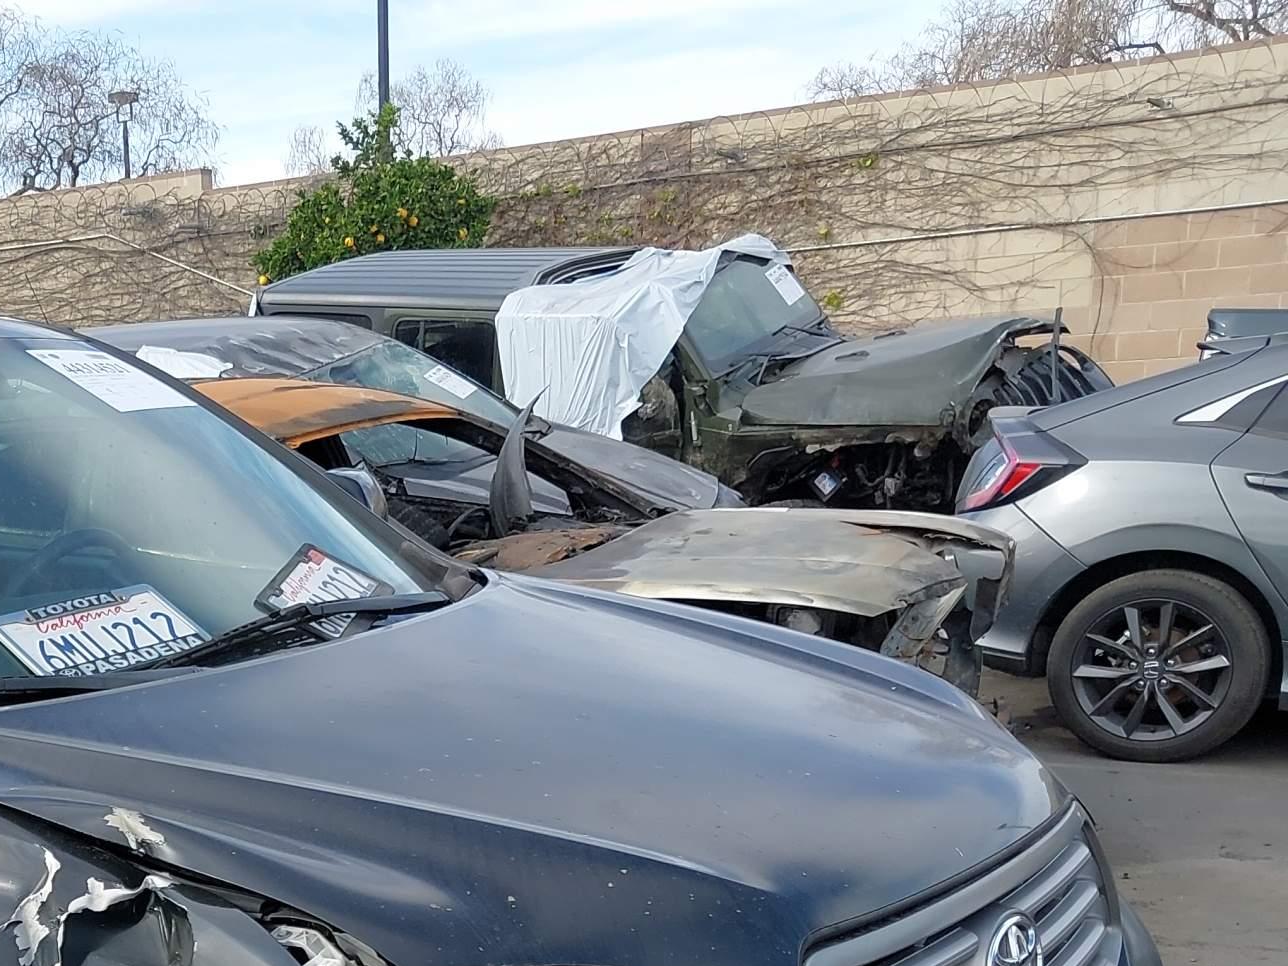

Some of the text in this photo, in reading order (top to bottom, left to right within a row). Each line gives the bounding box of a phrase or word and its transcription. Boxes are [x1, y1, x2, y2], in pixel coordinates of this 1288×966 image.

[61, 362, 133, 375] 44314521
[284, 564, 322, 602] California
[32, 593, 116, 620] TOYOTA
[36, 605, 137, 634] California
[81, 634, 205, 676] PASADENA
